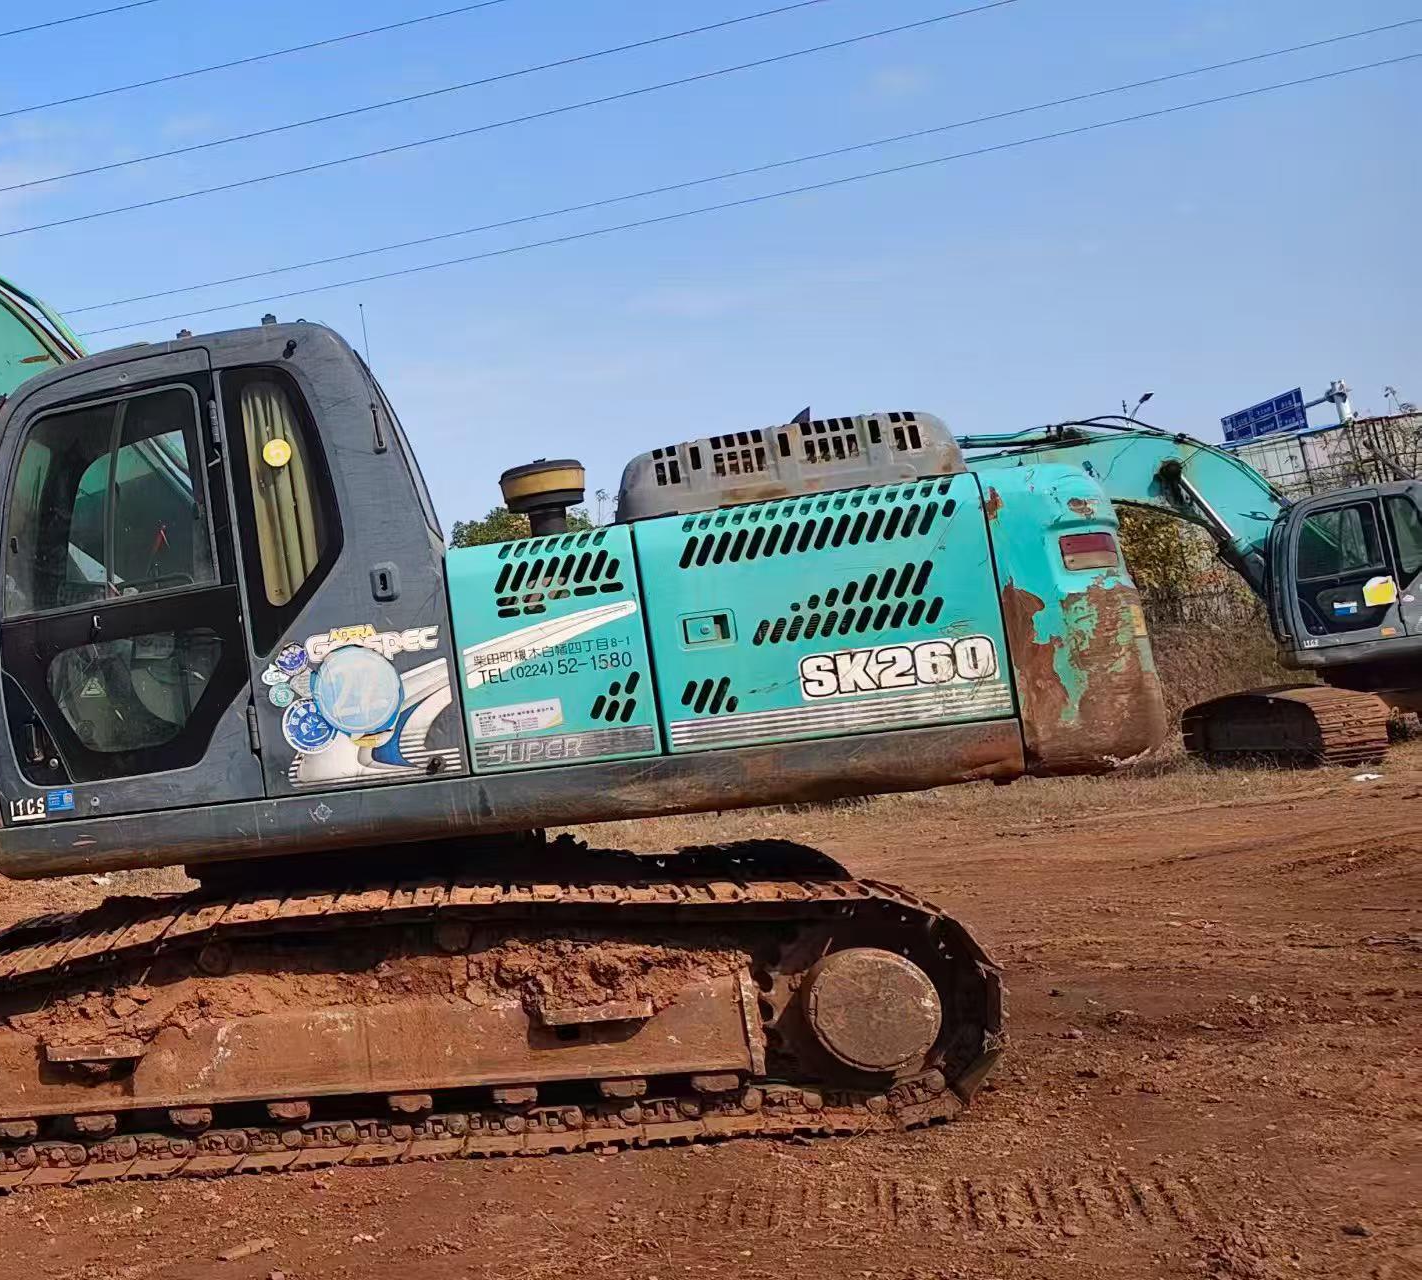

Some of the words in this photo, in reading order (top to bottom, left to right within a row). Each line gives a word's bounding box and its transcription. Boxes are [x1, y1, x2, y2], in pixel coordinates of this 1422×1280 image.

[801, 635, 997, 699] SK260
[487, 737, 583, 765] SUPER
[10, 797, 45, 816] ITCS
